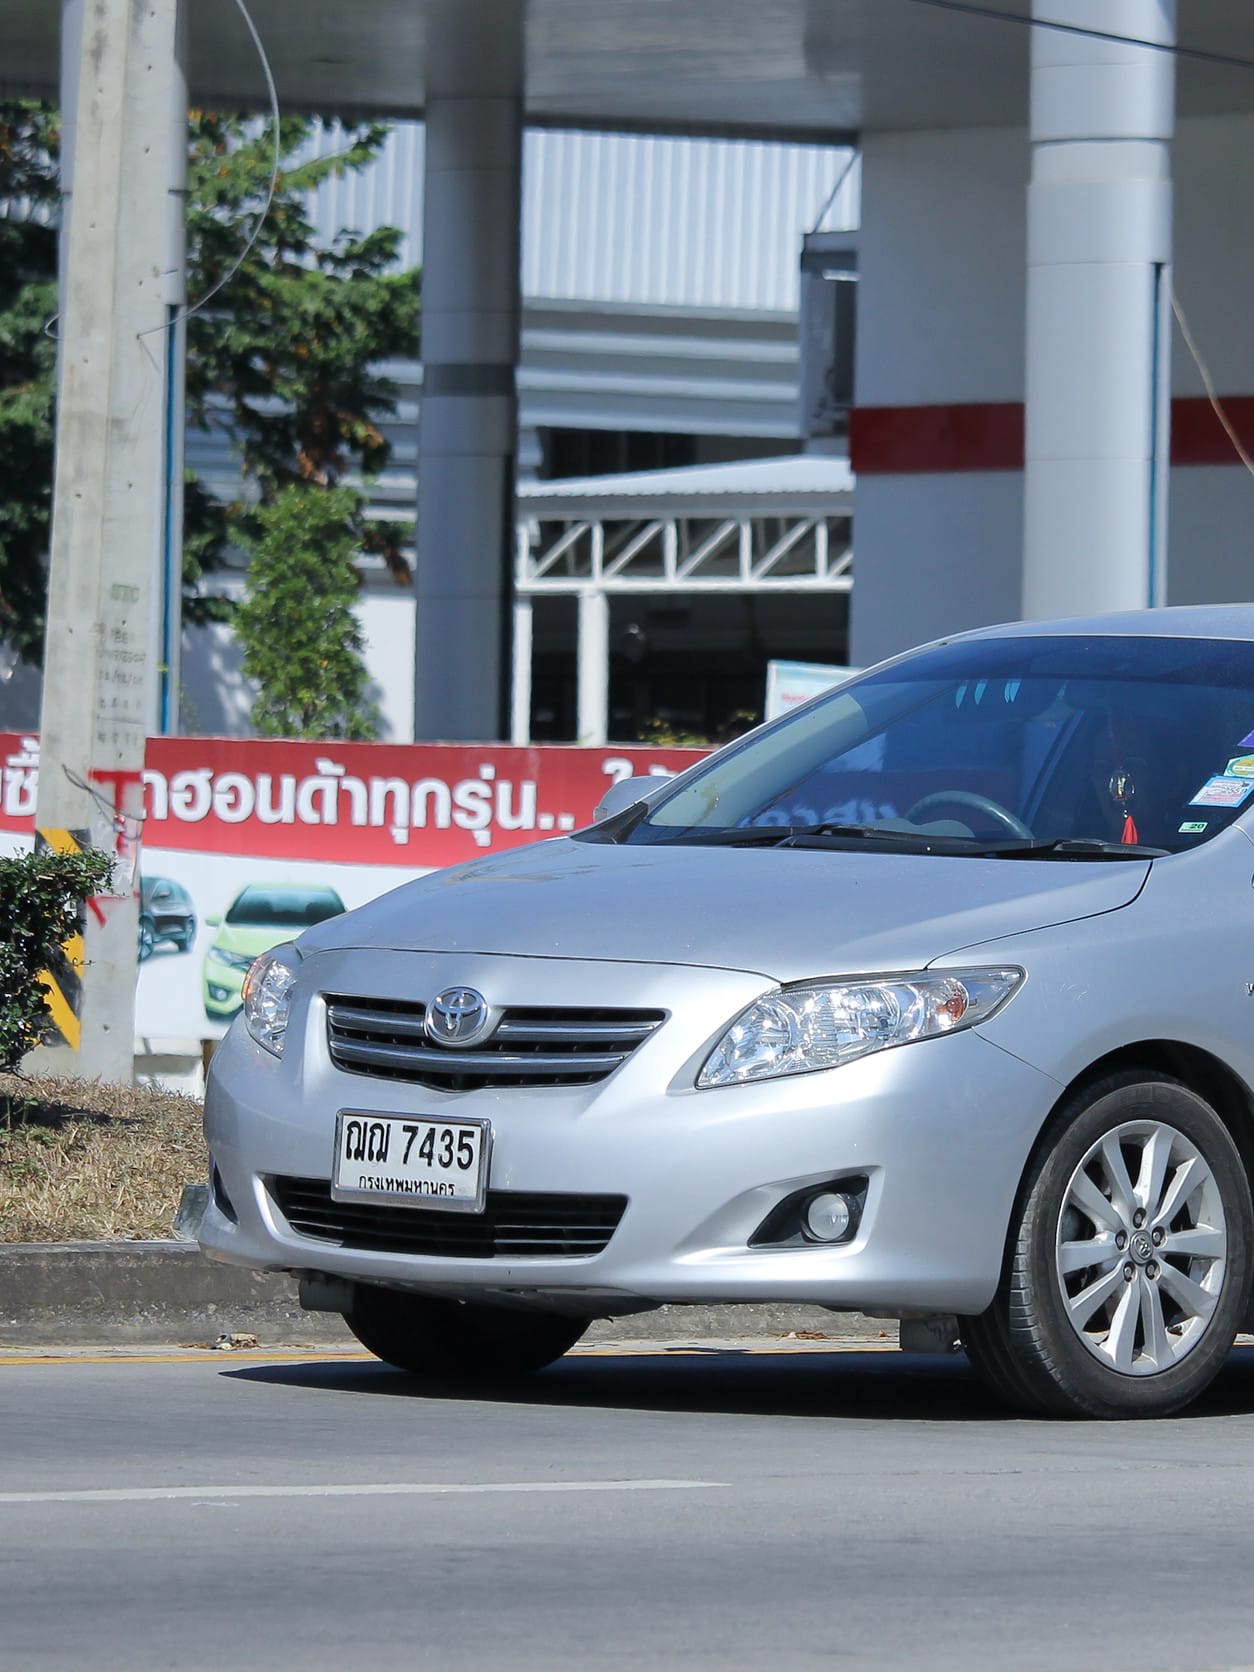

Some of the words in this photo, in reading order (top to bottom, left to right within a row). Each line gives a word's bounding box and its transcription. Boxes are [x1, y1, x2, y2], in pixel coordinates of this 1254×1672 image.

[345, 1120, 391, 1163] ฌฌ
[402, 1125, 475, 1170] 7435
[358, 1175, 456, 1197] กรงเทพมหานคร
